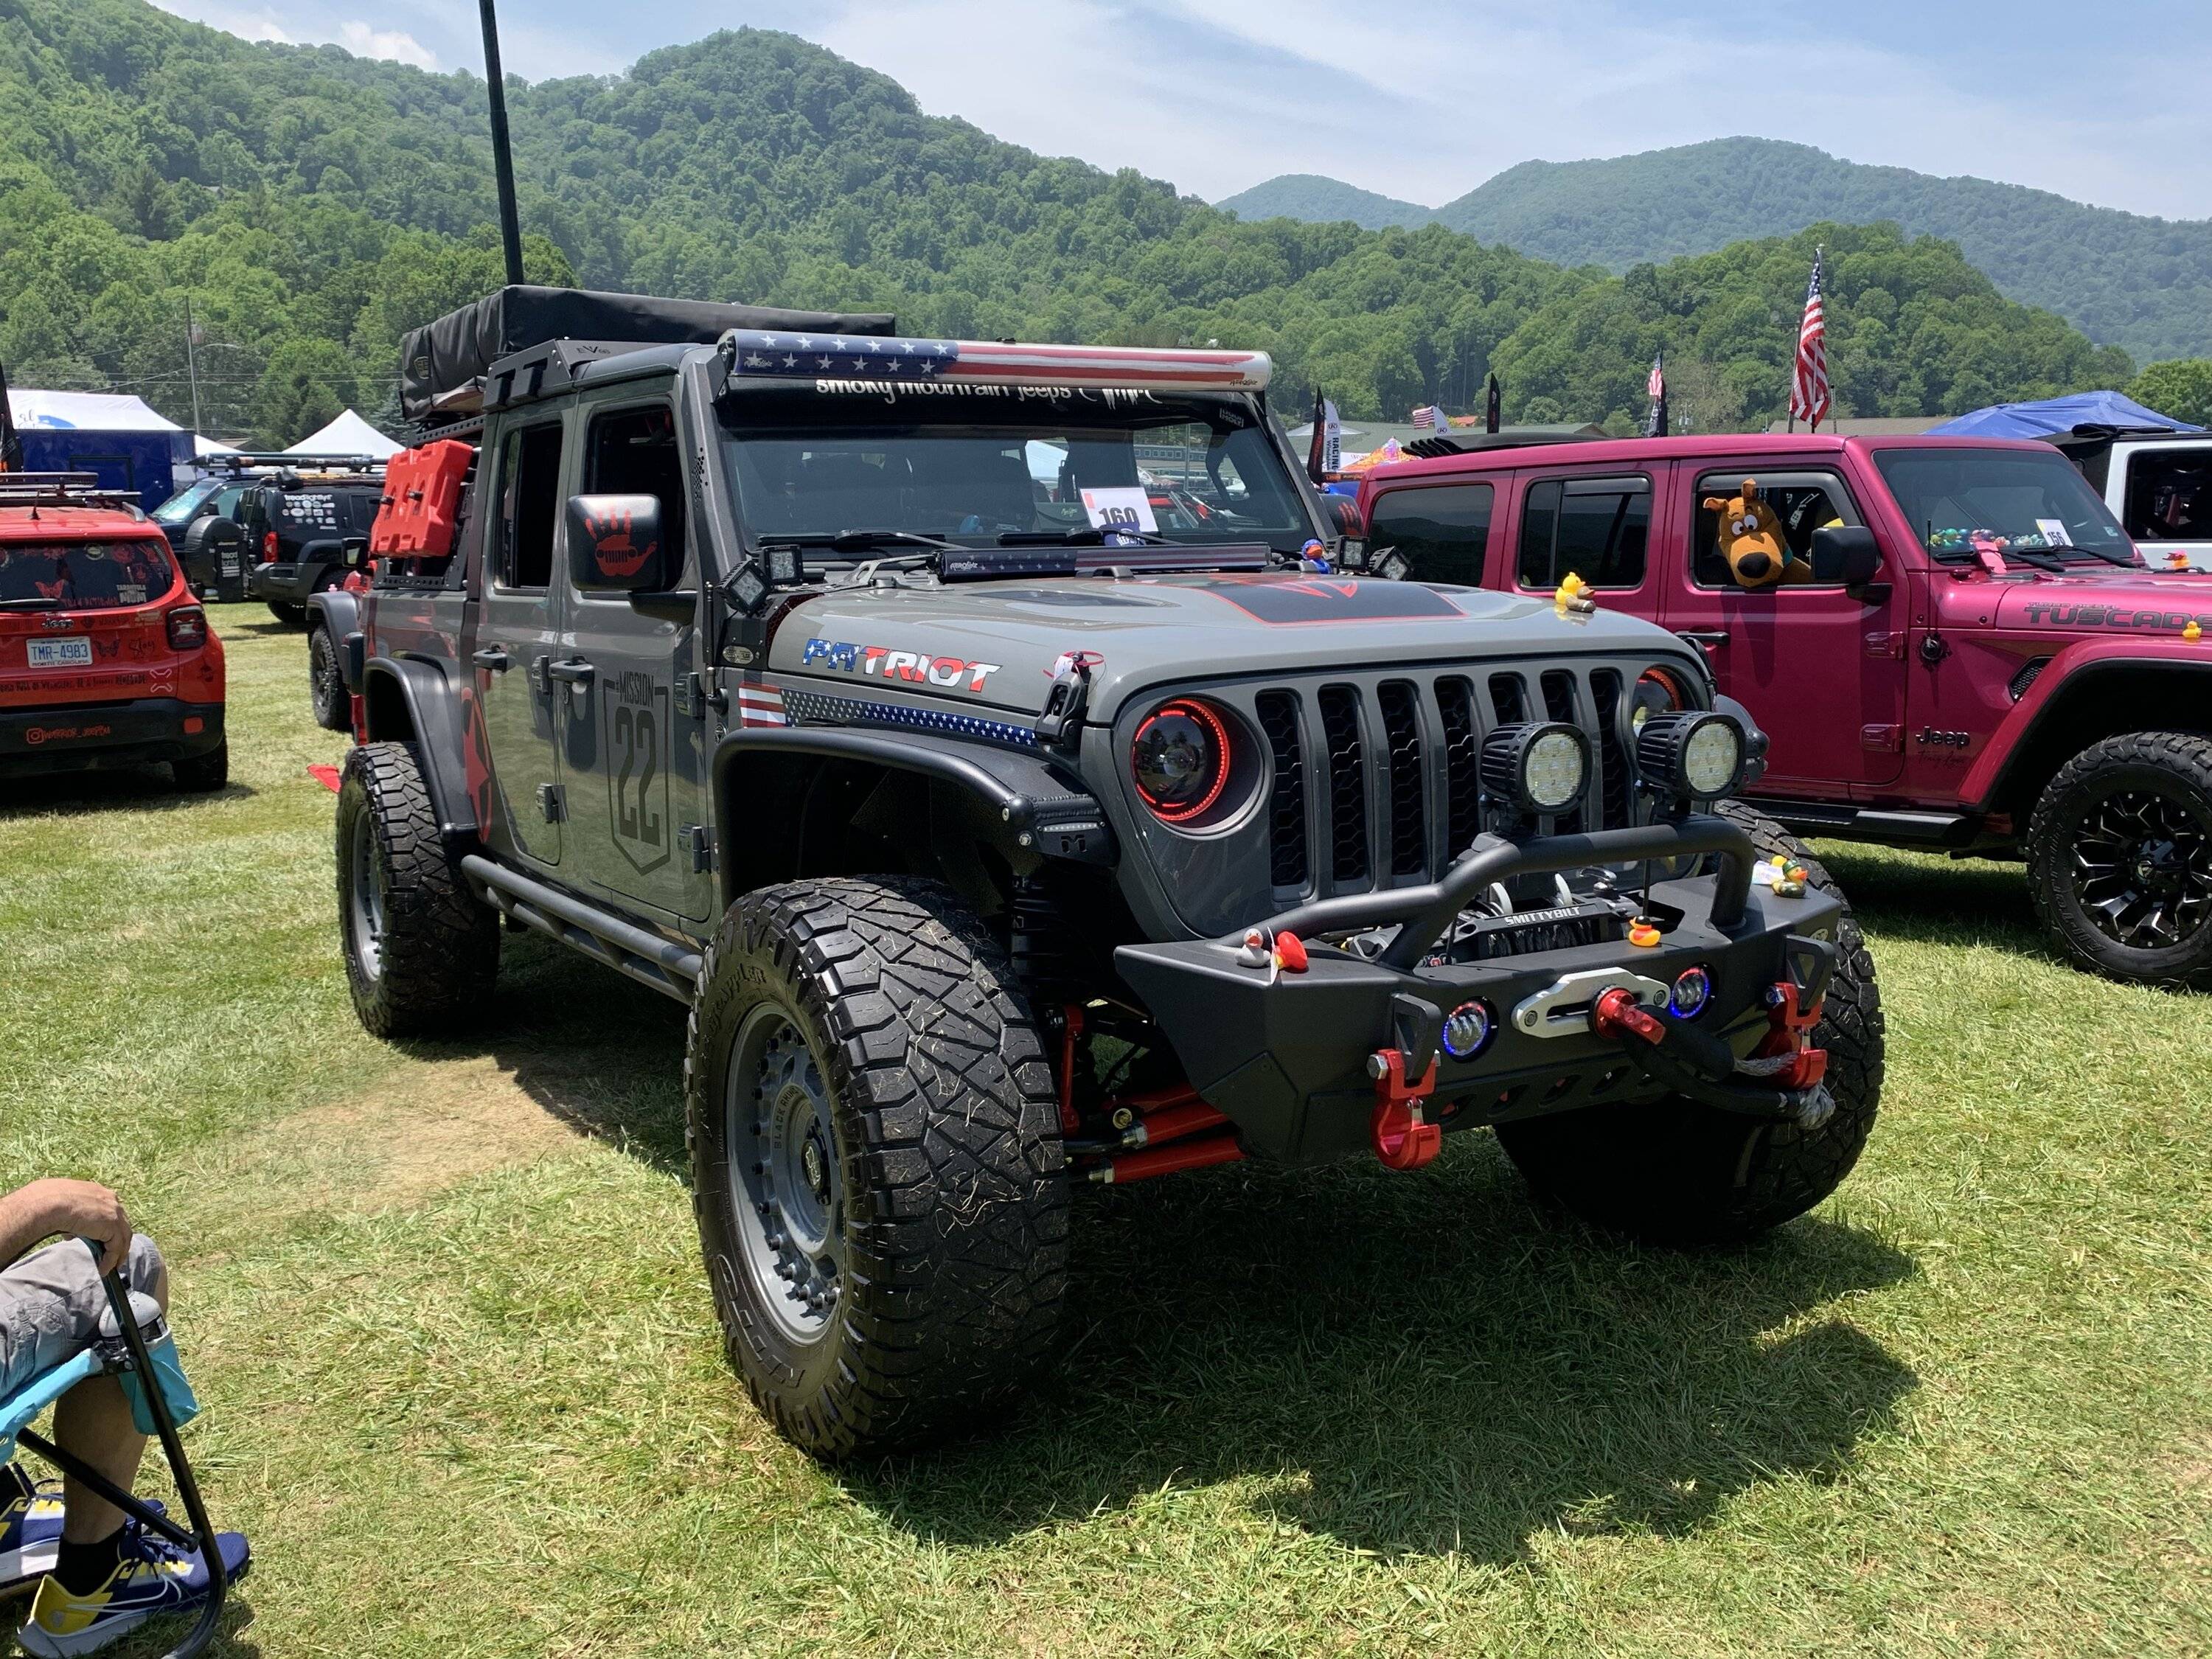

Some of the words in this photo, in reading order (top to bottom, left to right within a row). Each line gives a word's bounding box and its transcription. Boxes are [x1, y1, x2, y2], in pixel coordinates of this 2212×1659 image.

[41, 618, 74, 629] Jeep
[31, 644, 88, 661] TMR-4983
[802, 638, 1004, 693] PATRIOT
[619, 671, 654, 708] MISSION
[1915, 726, 1970, 750] Jeep
[615, 706, 661, 847] 22
[1504, 906, 1581, 925] SMITTYBILT
[773, 1107, 786, 1150] BLACK
